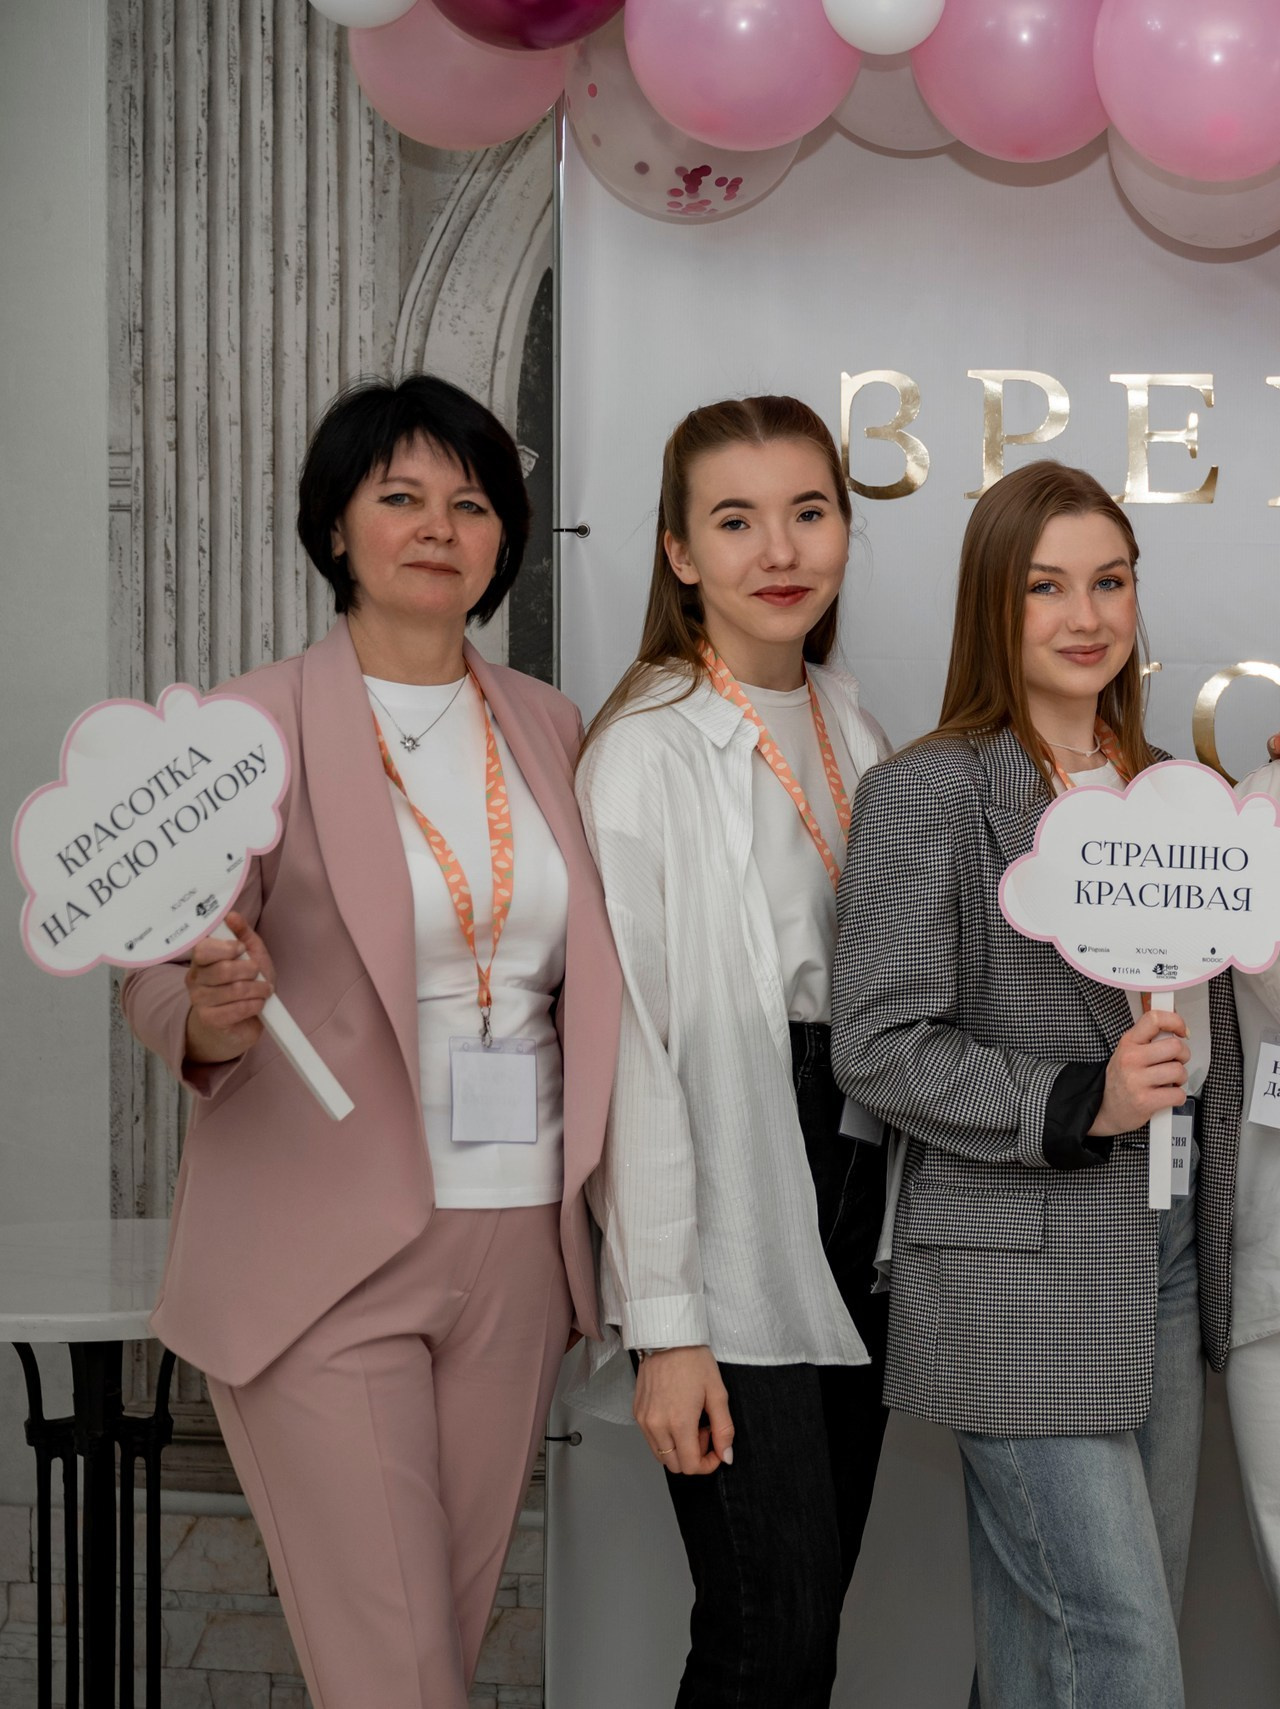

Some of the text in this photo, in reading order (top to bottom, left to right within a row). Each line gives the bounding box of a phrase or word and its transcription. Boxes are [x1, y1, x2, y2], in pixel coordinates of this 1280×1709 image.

[40, 744, 267, 947] НА ВСЮ ГОЛОВУ
[56, 746, 213, 877] КРАСОТКА
[1074, 879, 1253, 912] КРАСИВАЯ
[1080, 840, 1249, 872] СТРАШНО
